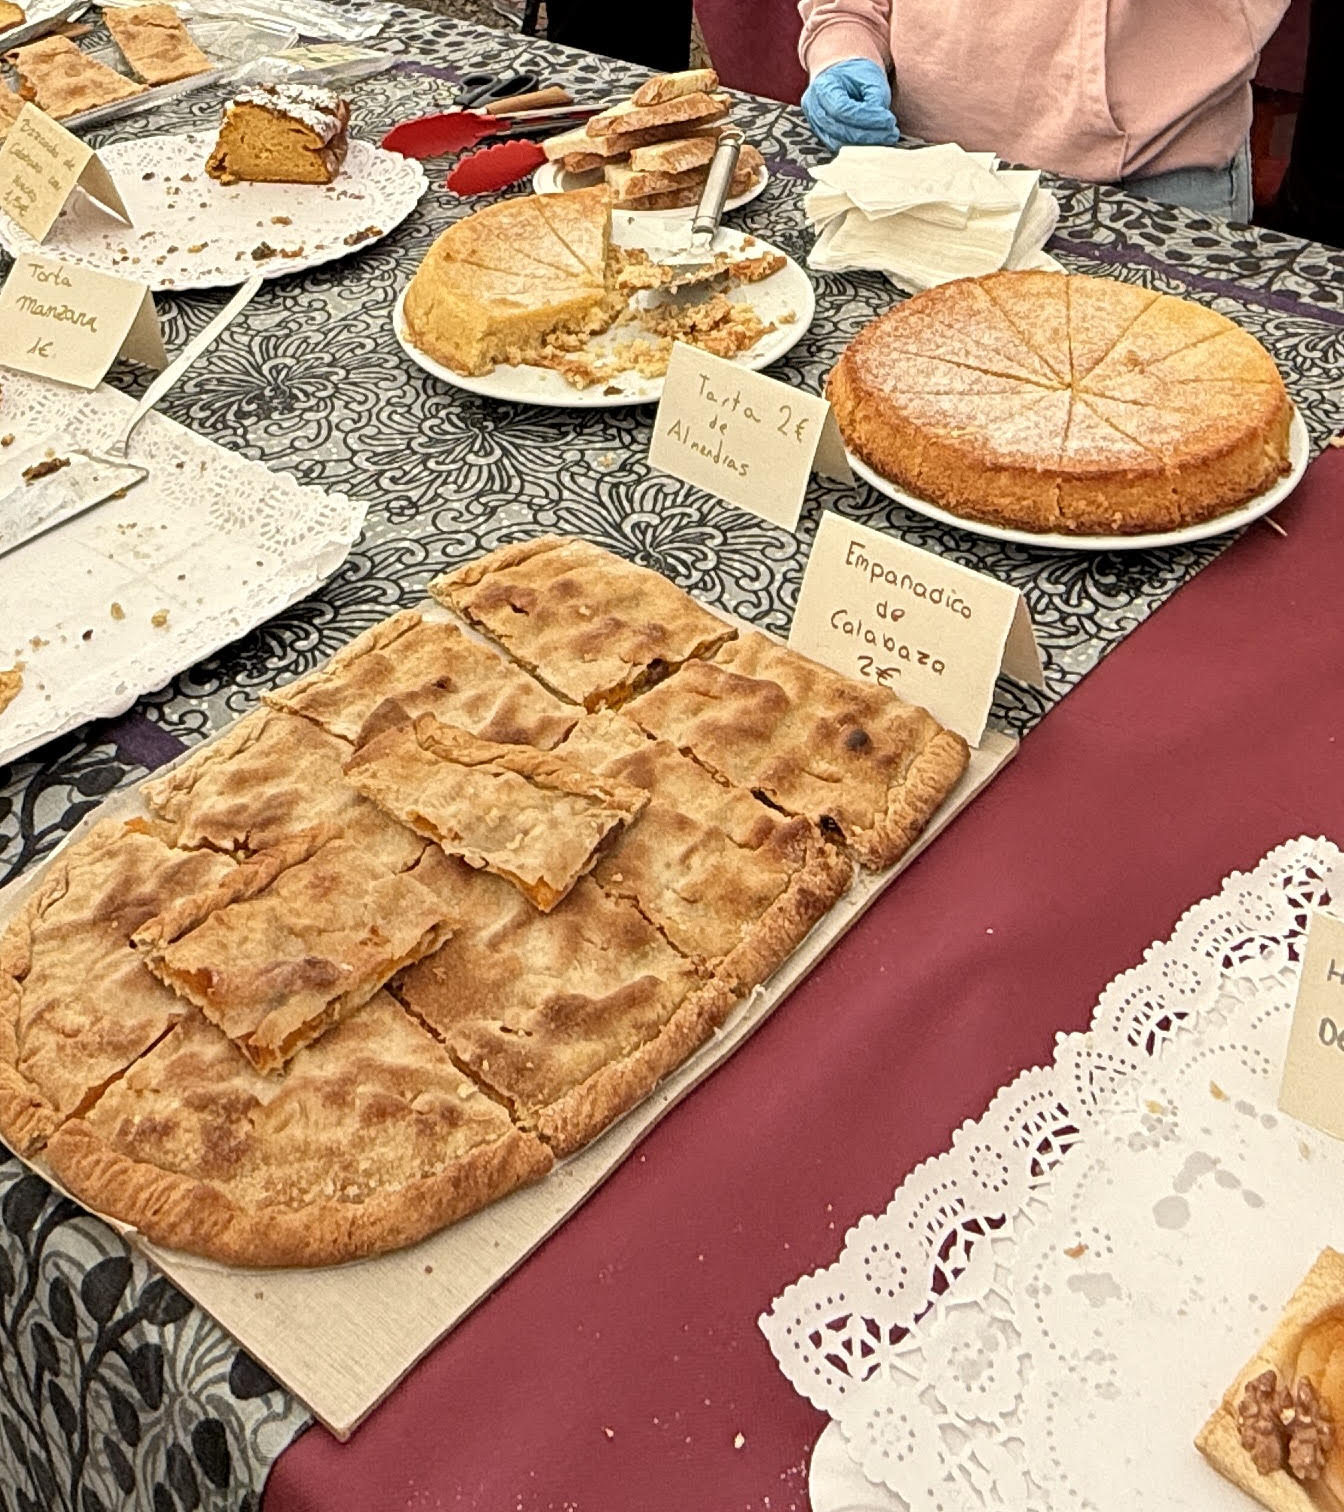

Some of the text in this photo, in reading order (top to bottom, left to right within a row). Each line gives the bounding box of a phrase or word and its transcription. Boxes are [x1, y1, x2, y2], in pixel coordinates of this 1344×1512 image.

[26, 336, 54, 358] 1€
[699, 372, 810, 444] Tarta 2€
[708, 414, 728, 436] de
[666, 418, 750, 477] Almendras
[845, 539, 973, 620] Empanadico
[875, 600, 906, 623] de
[830, 608, 946, 676] Calabaza
[856, 654, 902, 689] 2€
